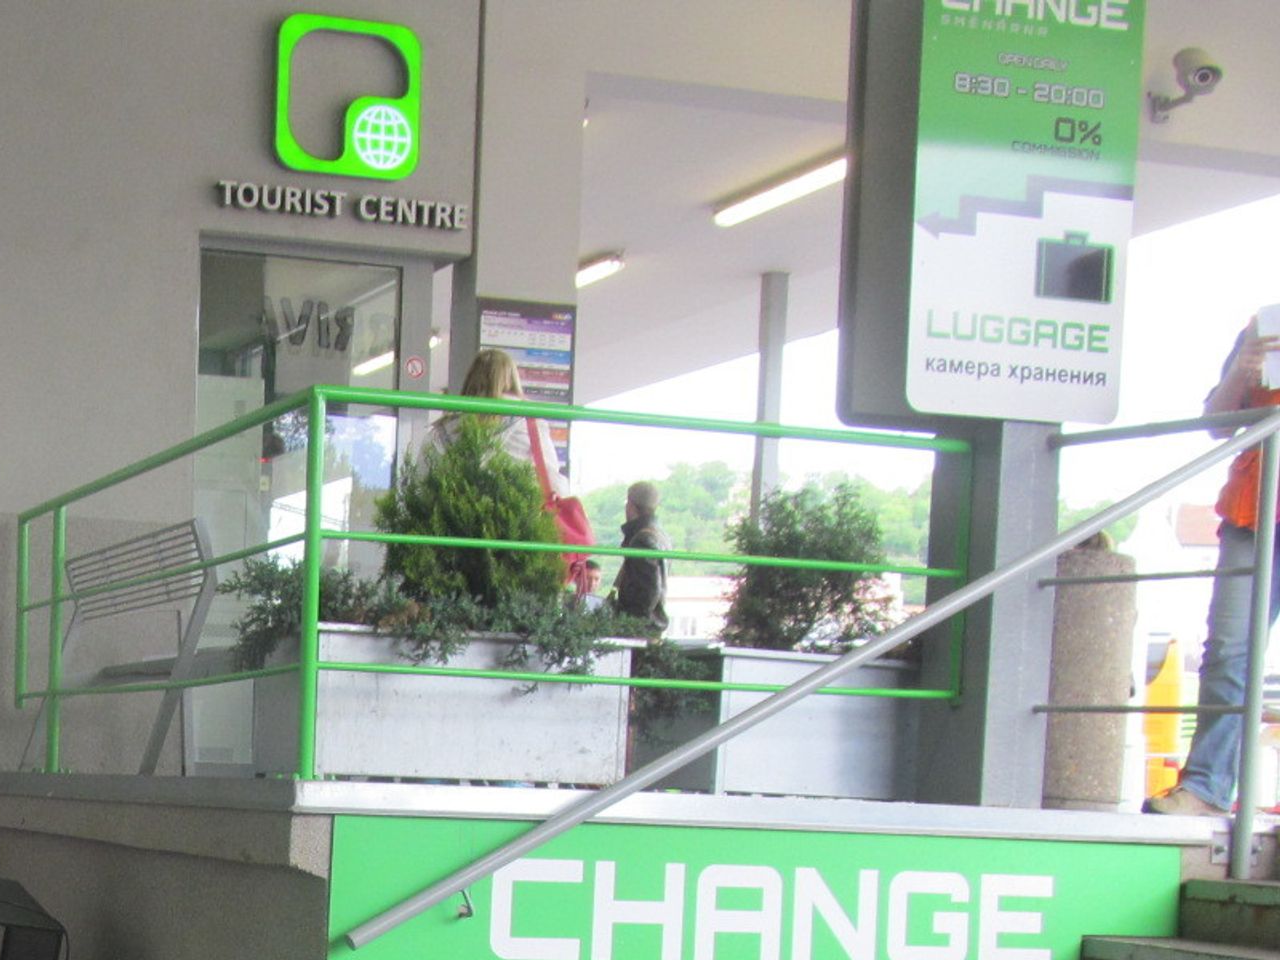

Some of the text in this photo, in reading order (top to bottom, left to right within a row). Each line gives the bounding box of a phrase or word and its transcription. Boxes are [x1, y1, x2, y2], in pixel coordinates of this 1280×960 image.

[954, 71, 1010, 98] 8:30
[1034, 82, 1105, 109] 20:00
[1055, 116, 1102, 146] 0%
[1011, 140, 1101, 161] COMMISSION
[219, 180, 469, 230] TOURIST CENTRE
[926, 308, 1110, 354] LUGGAGE
[924, 356, 1108, 387] камера хранения
